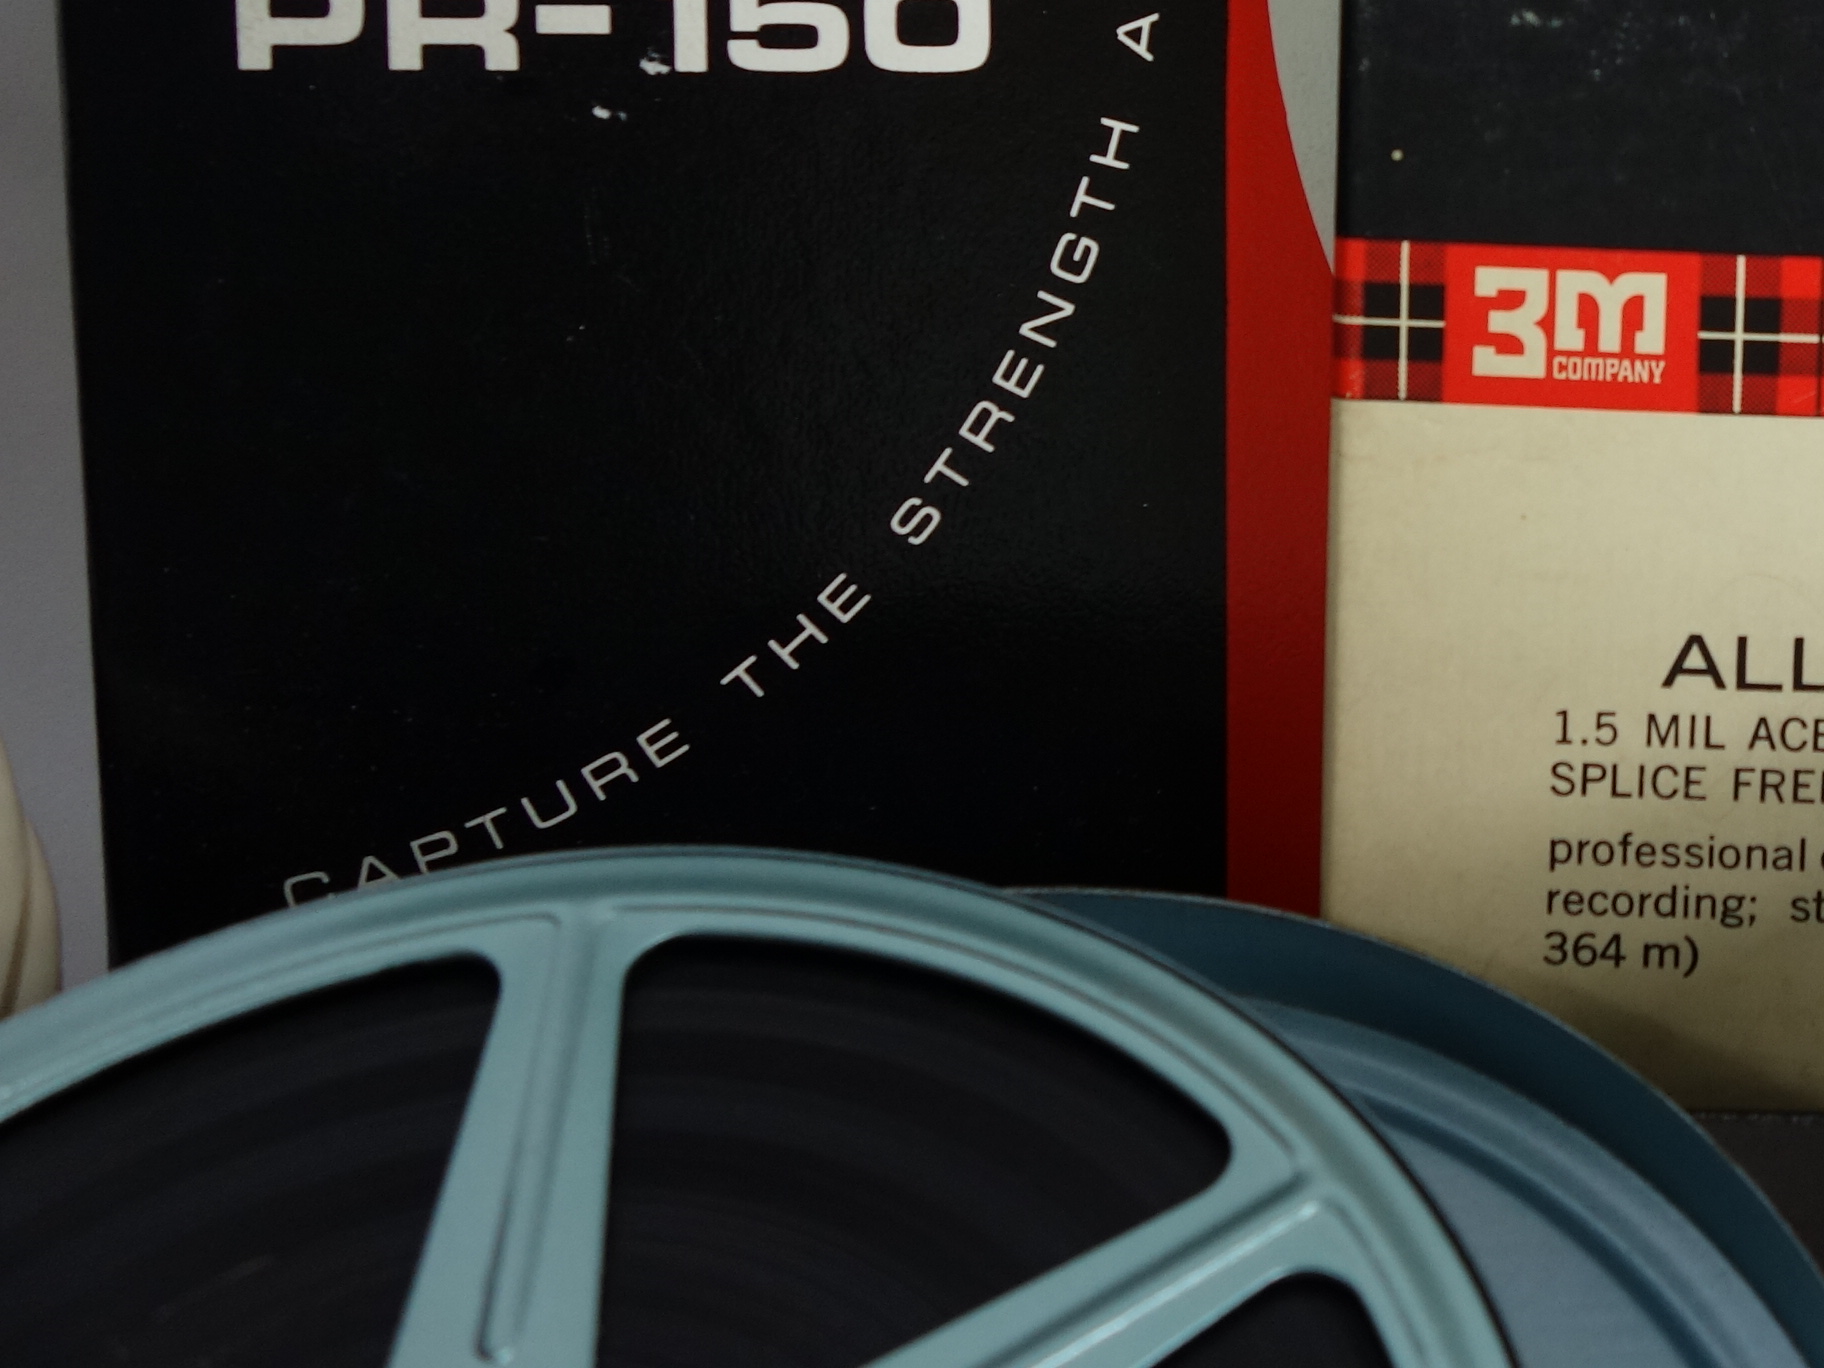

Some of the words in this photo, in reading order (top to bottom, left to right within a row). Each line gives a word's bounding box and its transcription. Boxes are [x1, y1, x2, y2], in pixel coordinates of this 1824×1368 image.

[1472, 265, 1668, 380] 3M
[1552, 355, 1666, 384] COMPANY
[284, 718, 691, 909] CAPTURE
[720, 573, 871, 697] THE
[890, 117, 1140, 545] STRENGTH
[1555, 709, 1619, 747] 1.5
[1645, 713, 1726, 750] MIL
[1550, 761, 1707, 801] SPLICE
[1548, 832, 1806, 873] professional
[1546, 884, 1758, 929] recording;
[1543, 931, 1627, 970] 364
[1642, 936, 1700, 978] m)
